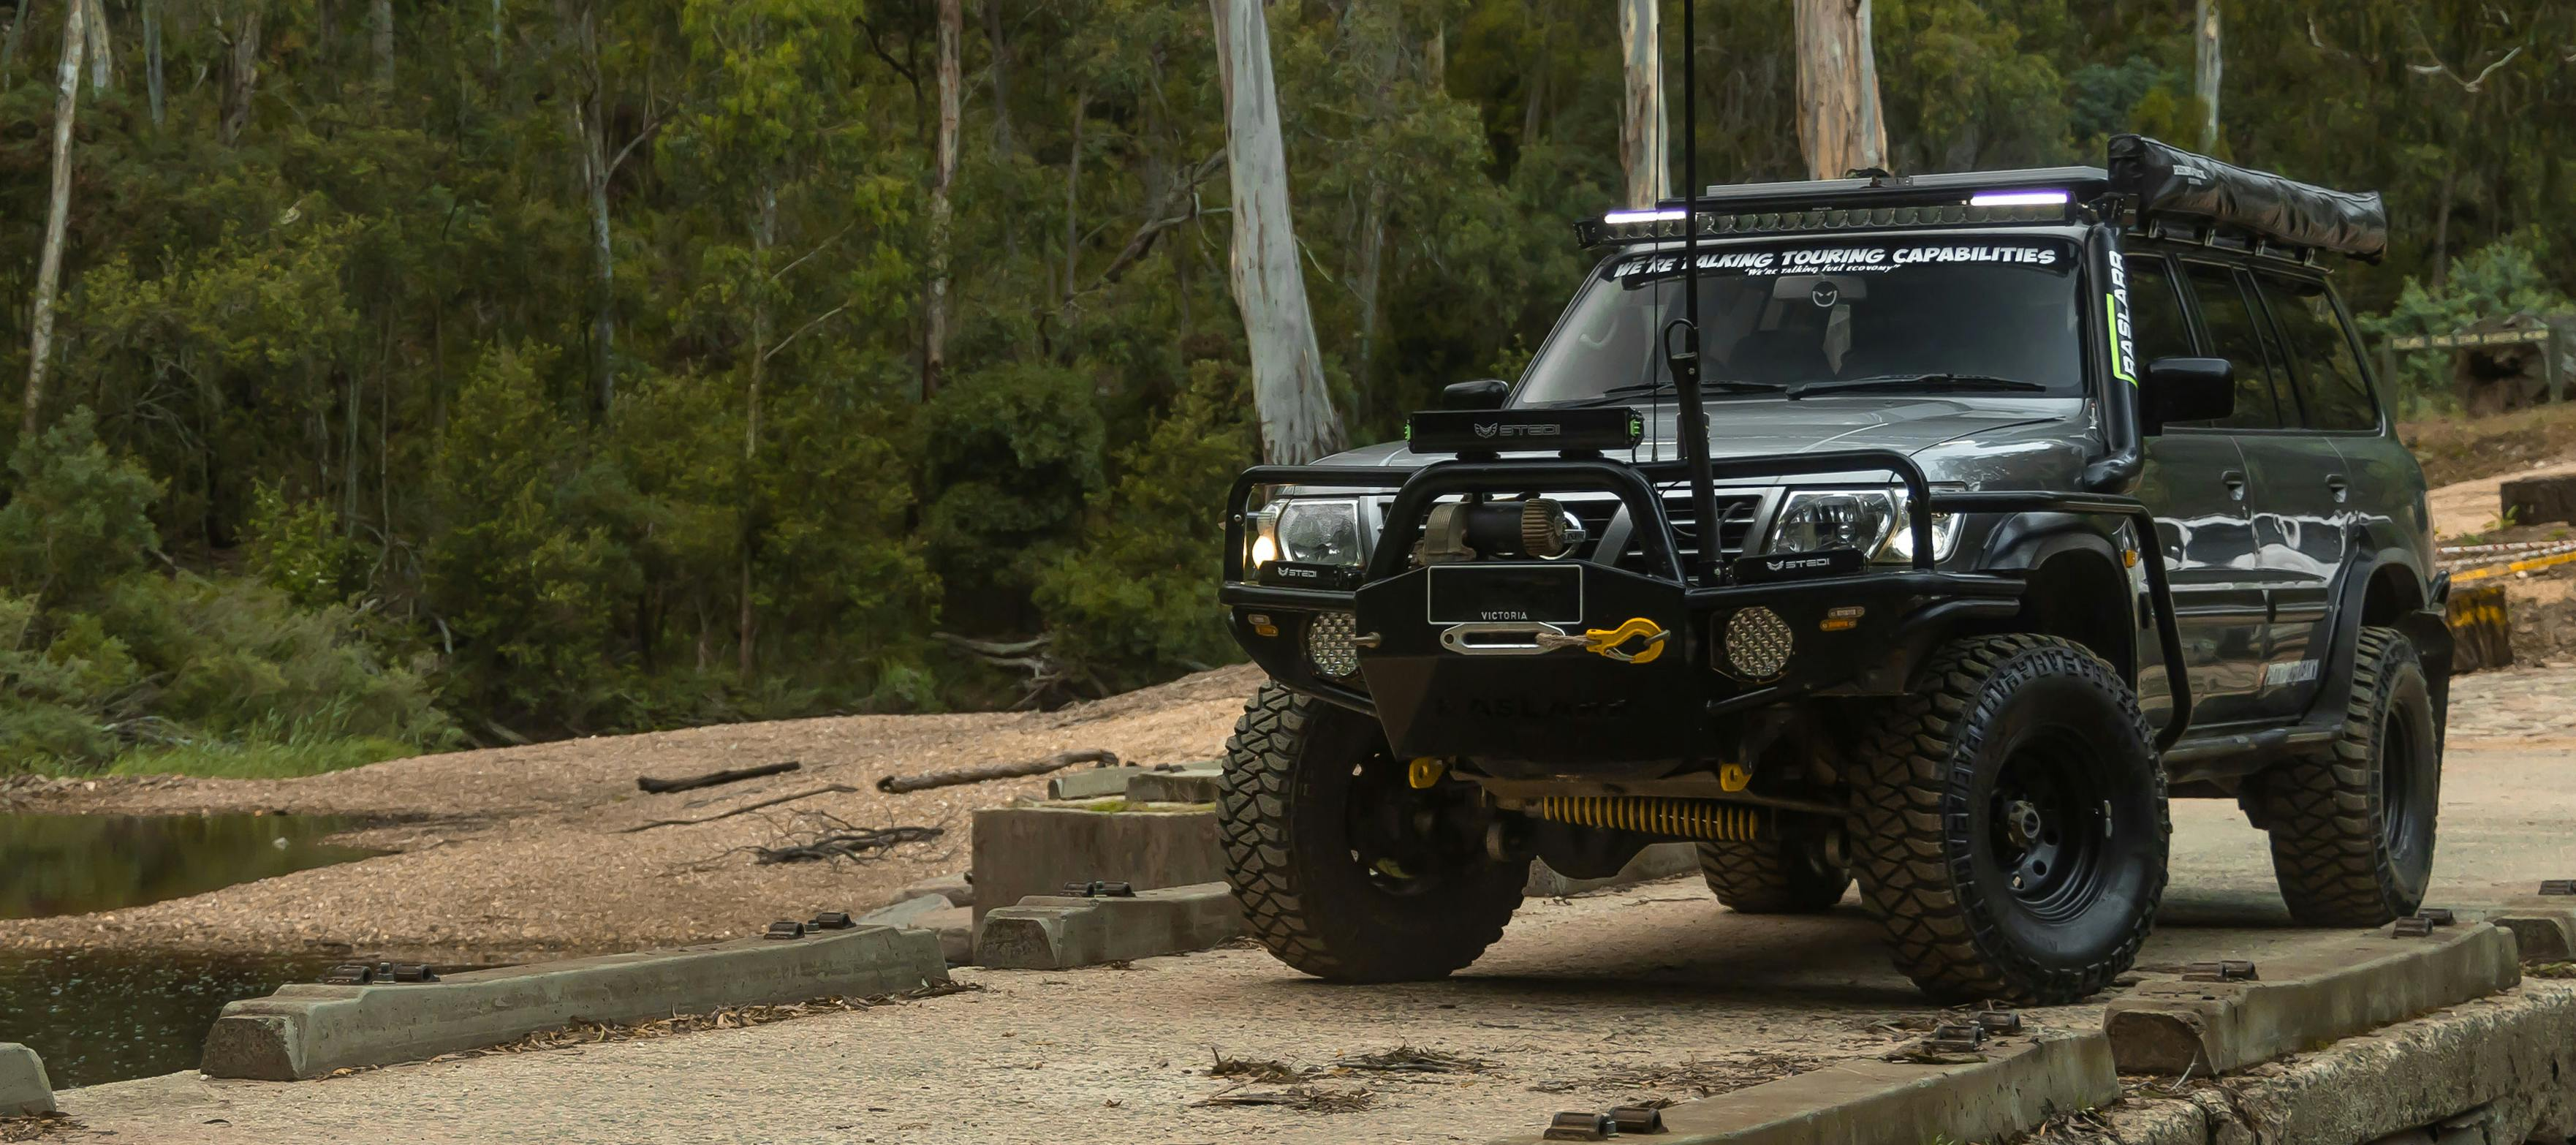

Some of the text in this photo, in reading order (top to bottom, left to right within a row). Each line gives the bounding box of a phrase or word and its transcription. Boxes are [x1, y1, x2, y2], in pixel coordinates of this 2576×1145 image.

[1781, 249, 1886, 265] TOURING
[1893, 247, 2056, 264] CAPABILITIES
[2109, 250, 2137, 379] RASLARR
[1499, 424, 1561, 436] STEDI
[1785, 558, 1830, 569] STEDI
[1289, 569, 1317, 578] STEDI
[1481, 611, 1528, 621] VICTORIA
